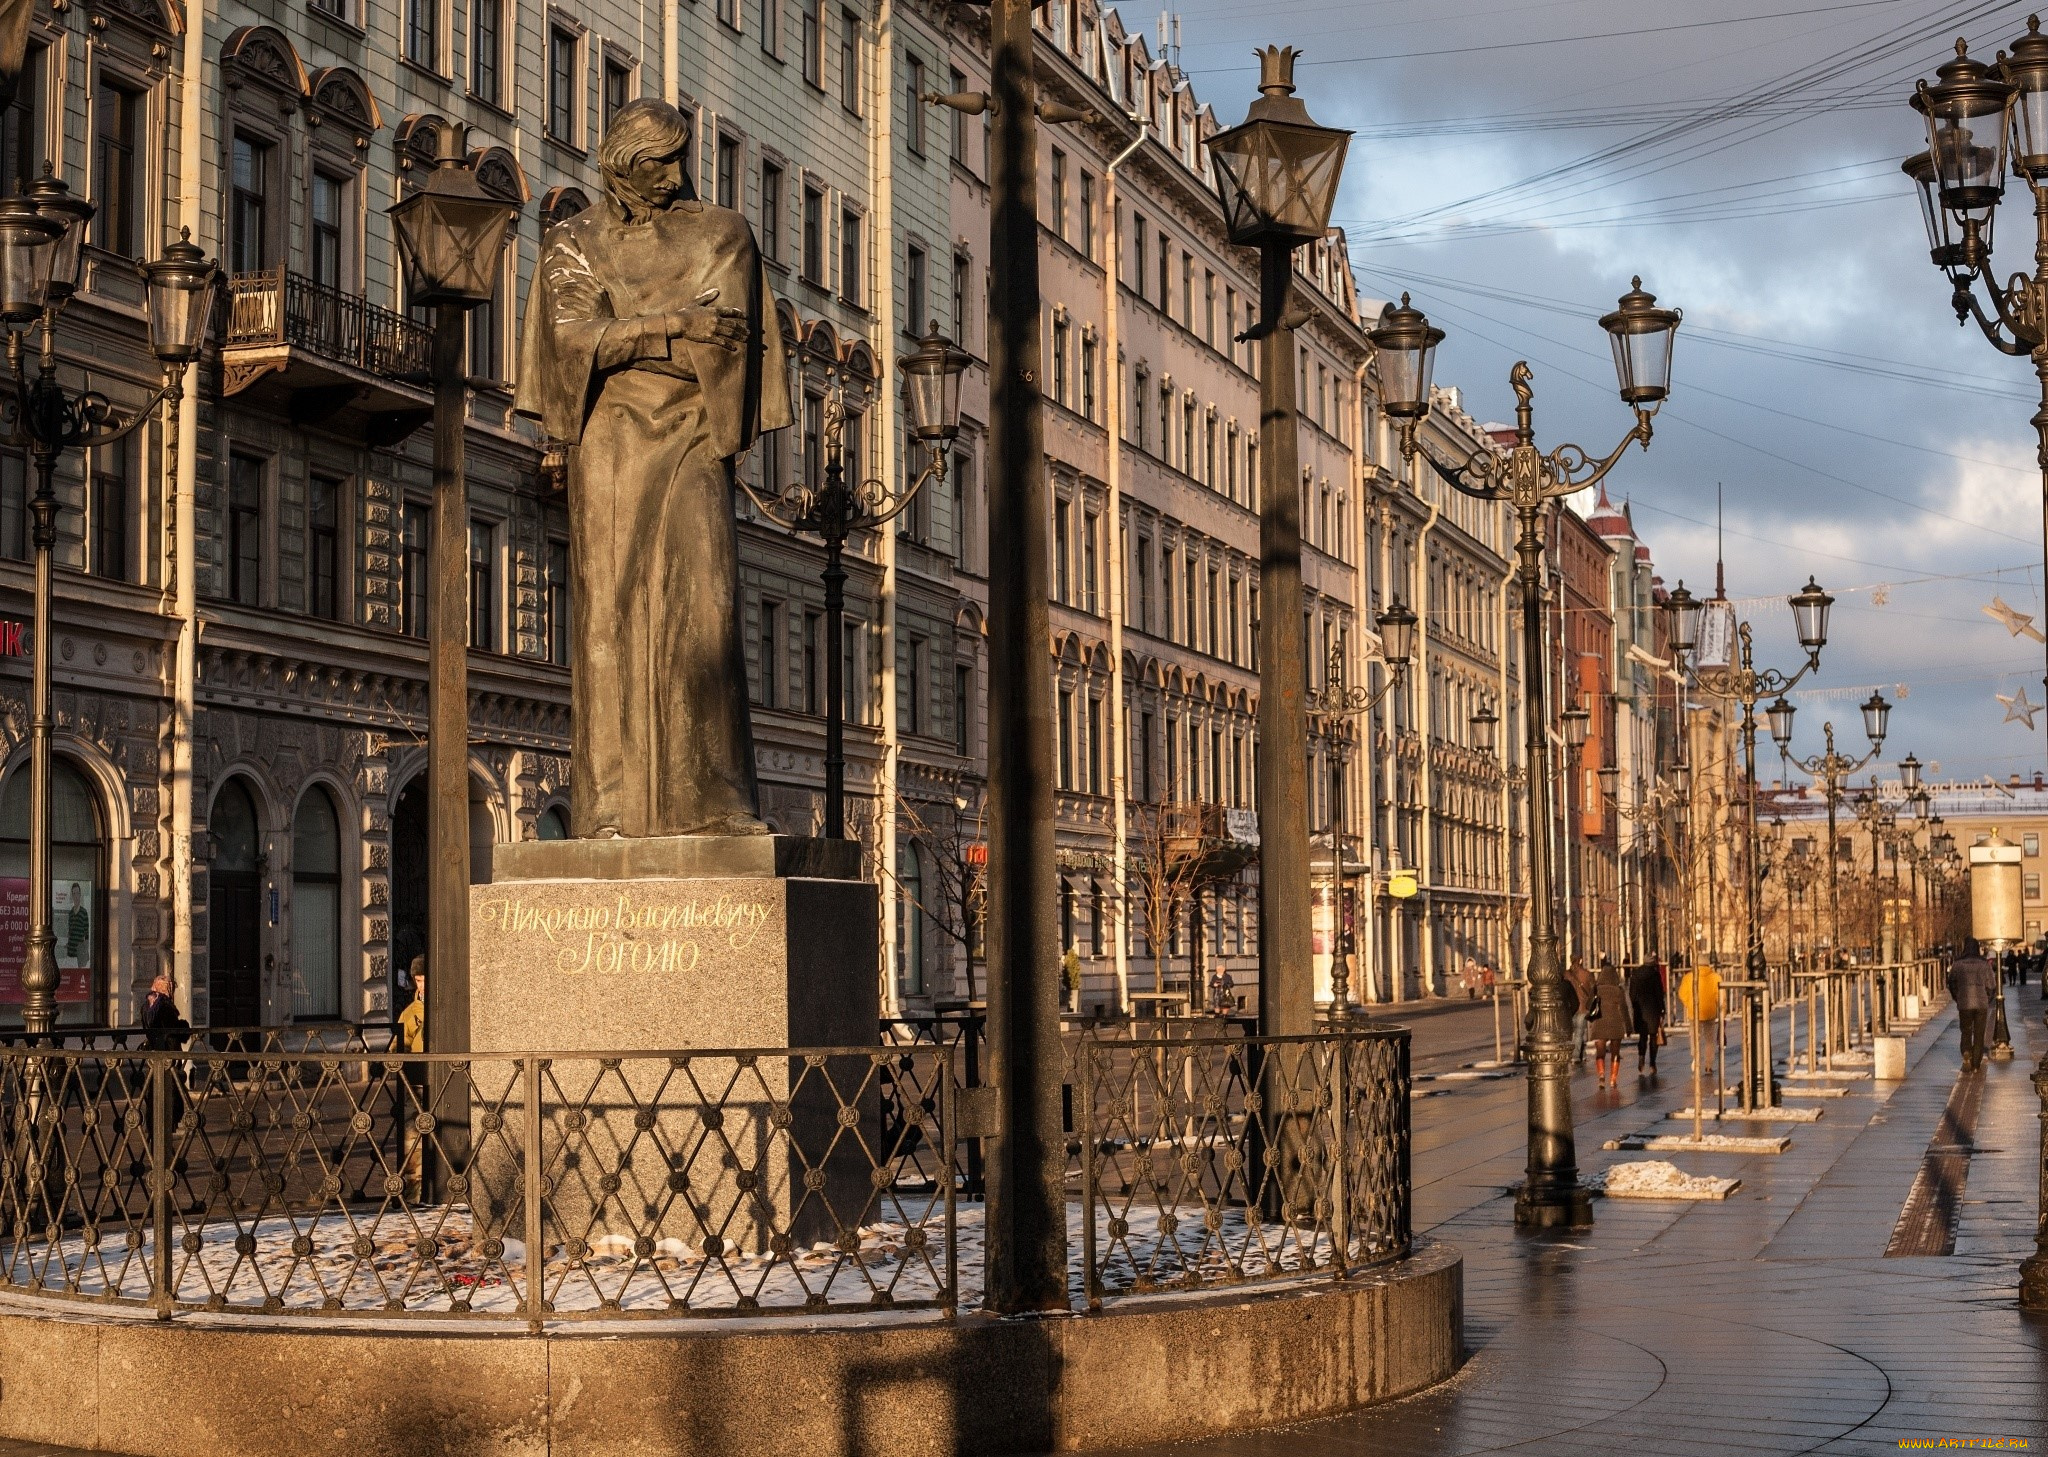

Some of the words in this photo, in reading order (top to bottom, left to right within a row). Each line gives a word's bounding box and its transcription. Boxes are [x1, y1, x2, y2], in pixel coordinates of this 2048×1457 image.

[6, 891, 29, 903] Кредит
[478, 898, 610, 944] Николаю
[615, 894, 774, 949] Васильевичу
[557, 932, 699, 974] Гоголю
